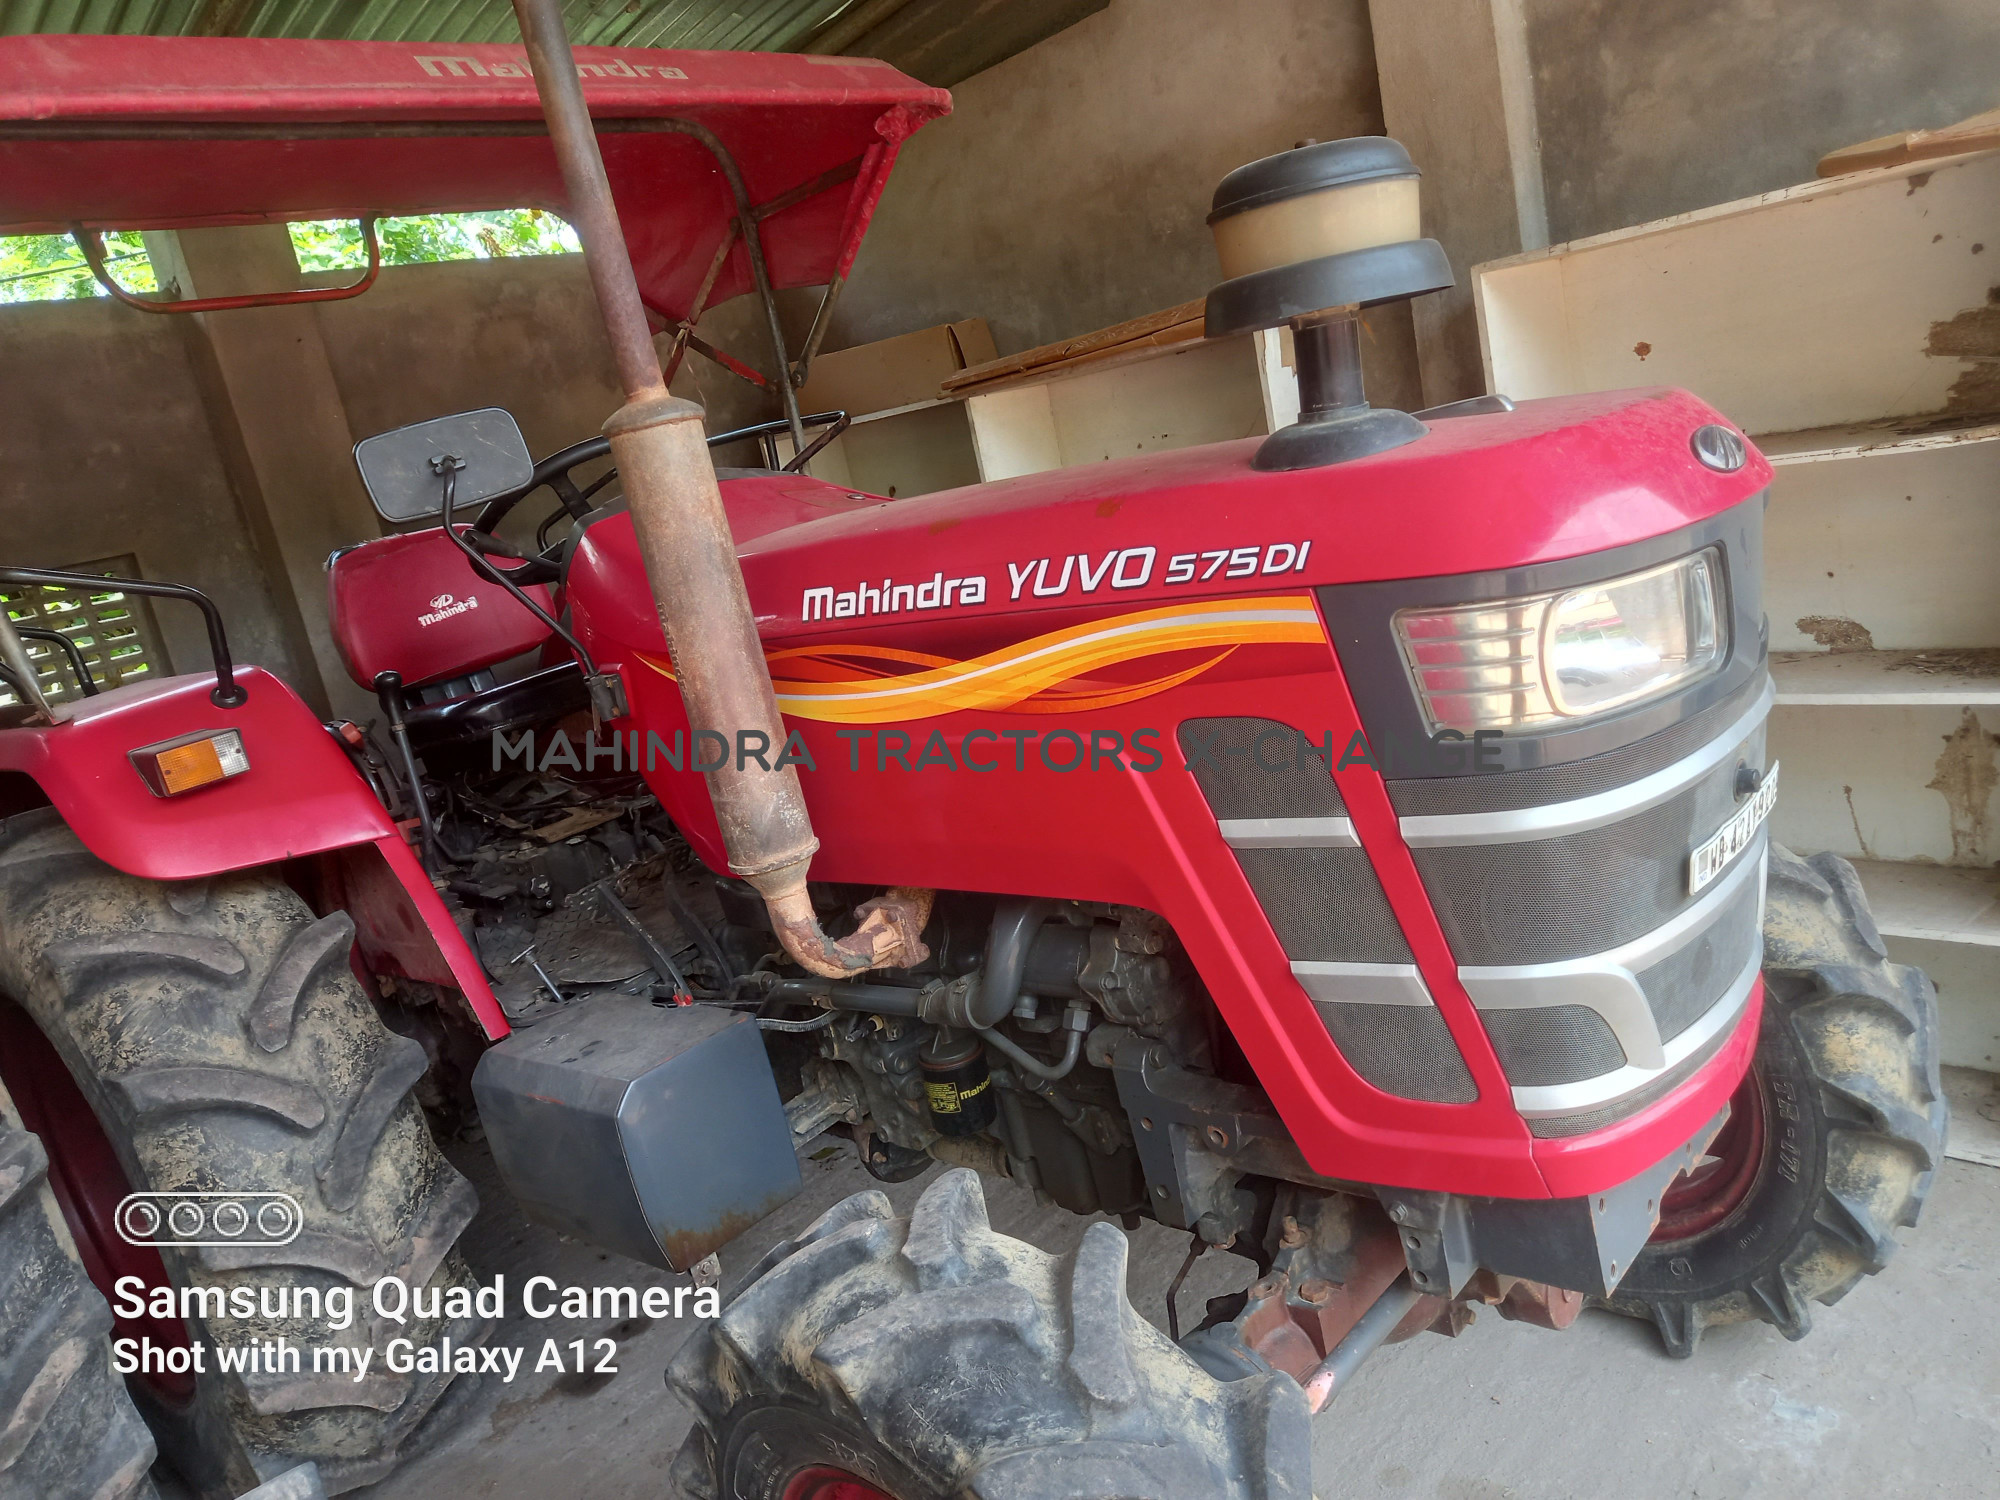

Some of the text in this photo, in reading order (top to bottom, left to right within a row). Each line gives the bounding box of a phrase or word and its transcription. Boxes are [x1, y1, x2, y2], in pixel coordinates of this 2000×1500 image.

[802, 540, 1313, 622] Mahindra YUVO 575DI
